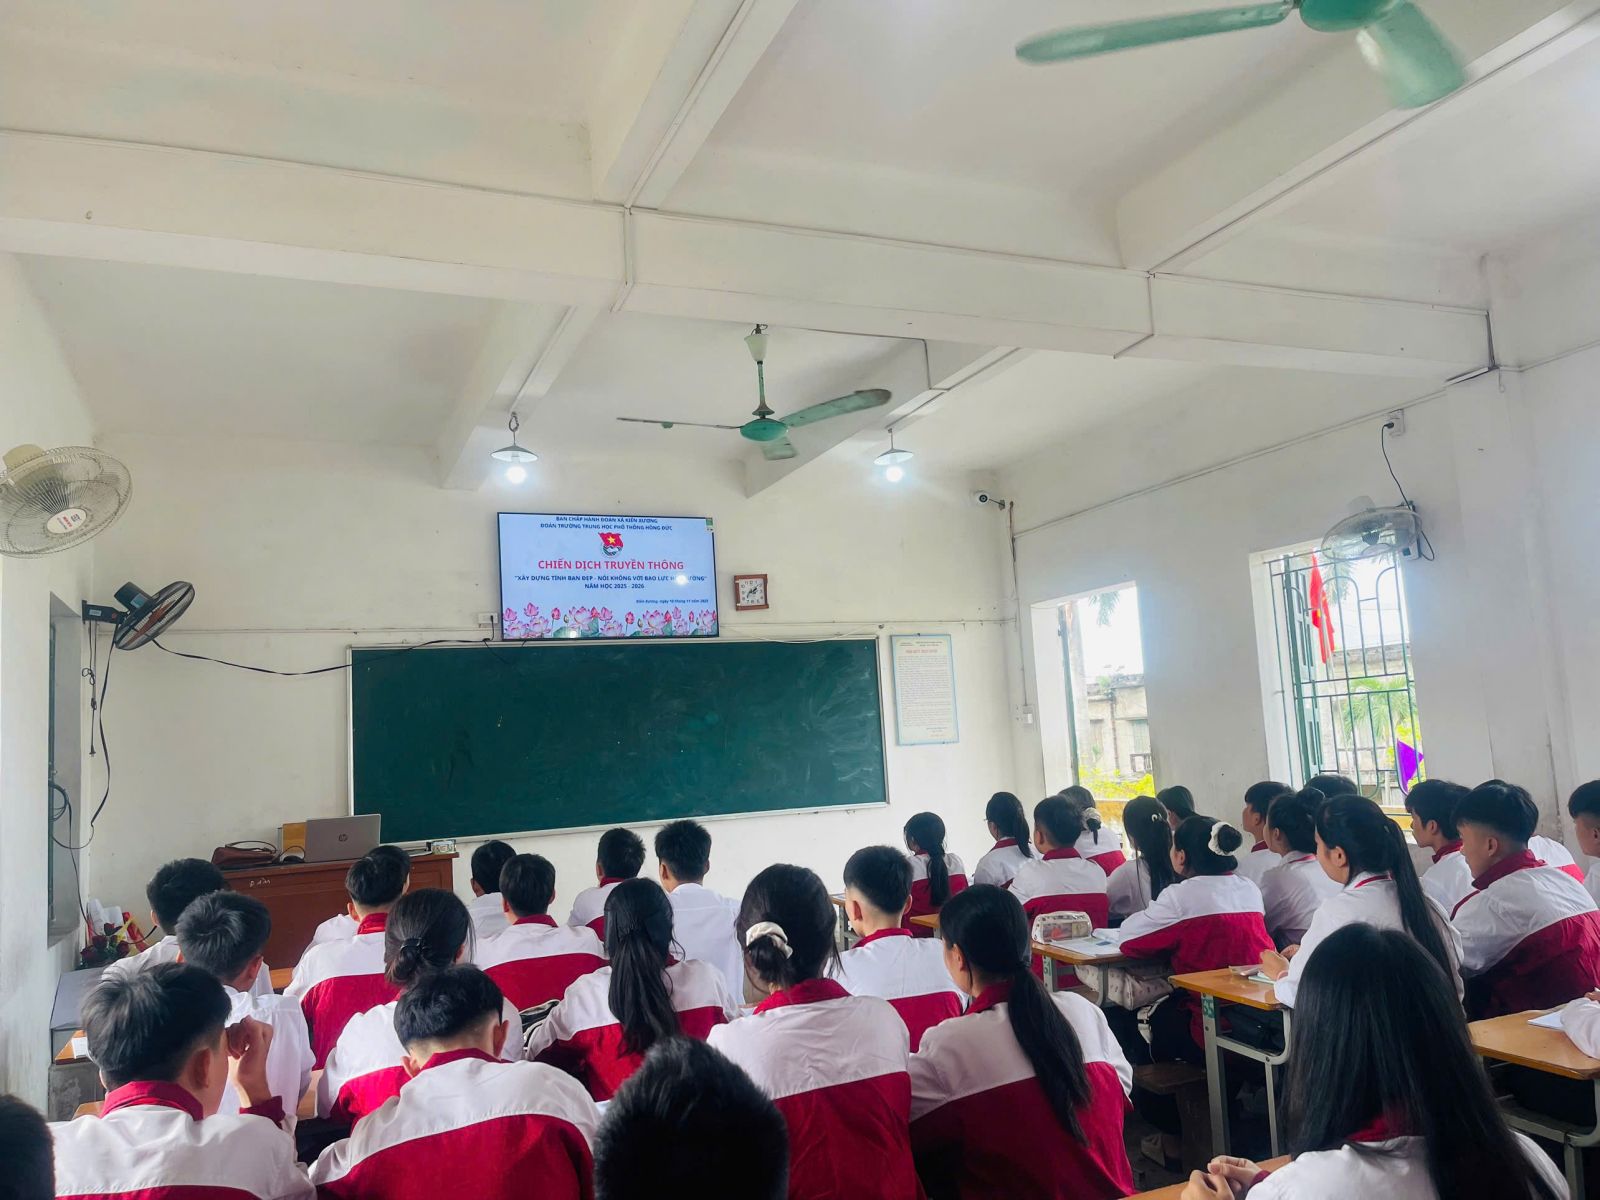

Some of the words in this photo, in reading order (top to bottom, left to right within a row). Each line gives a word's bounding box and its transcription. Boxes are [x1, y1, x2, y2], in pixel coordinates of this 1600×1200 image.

[538, 558, 572, 569] CHIẾN
[576, 560, 601, 571] DỊCH
[604, 558, 644, 570] TRUYỀN
[648, 559, 684, 570] THÔNG
